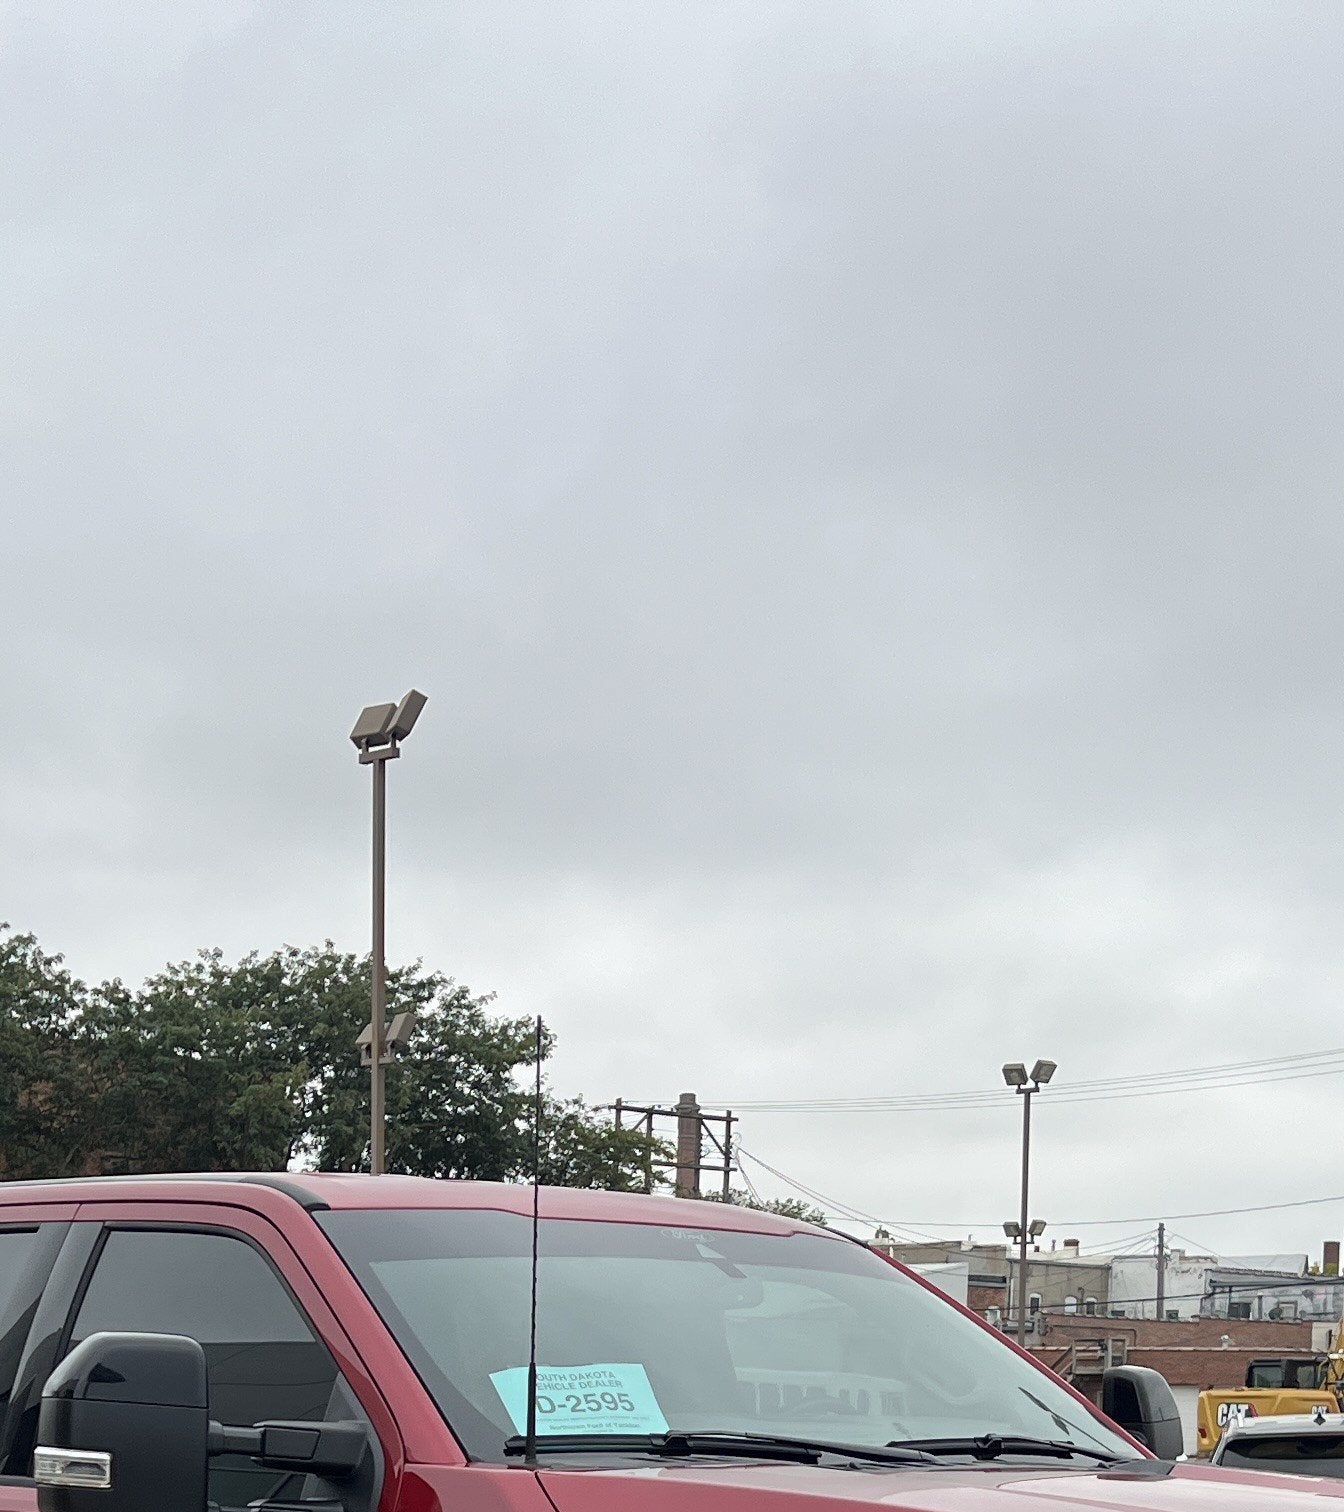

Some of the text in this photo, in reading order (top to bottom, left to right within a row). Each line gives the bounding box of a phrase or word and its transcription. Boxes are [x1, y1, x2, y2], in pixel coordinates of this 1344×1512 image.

[535, 1370, 616, 1382] OUTH DAKOTA
[535, 1380, 624, 1391] EHICLE DEALER
[1217, 1403, 1249, 1428] CAT
